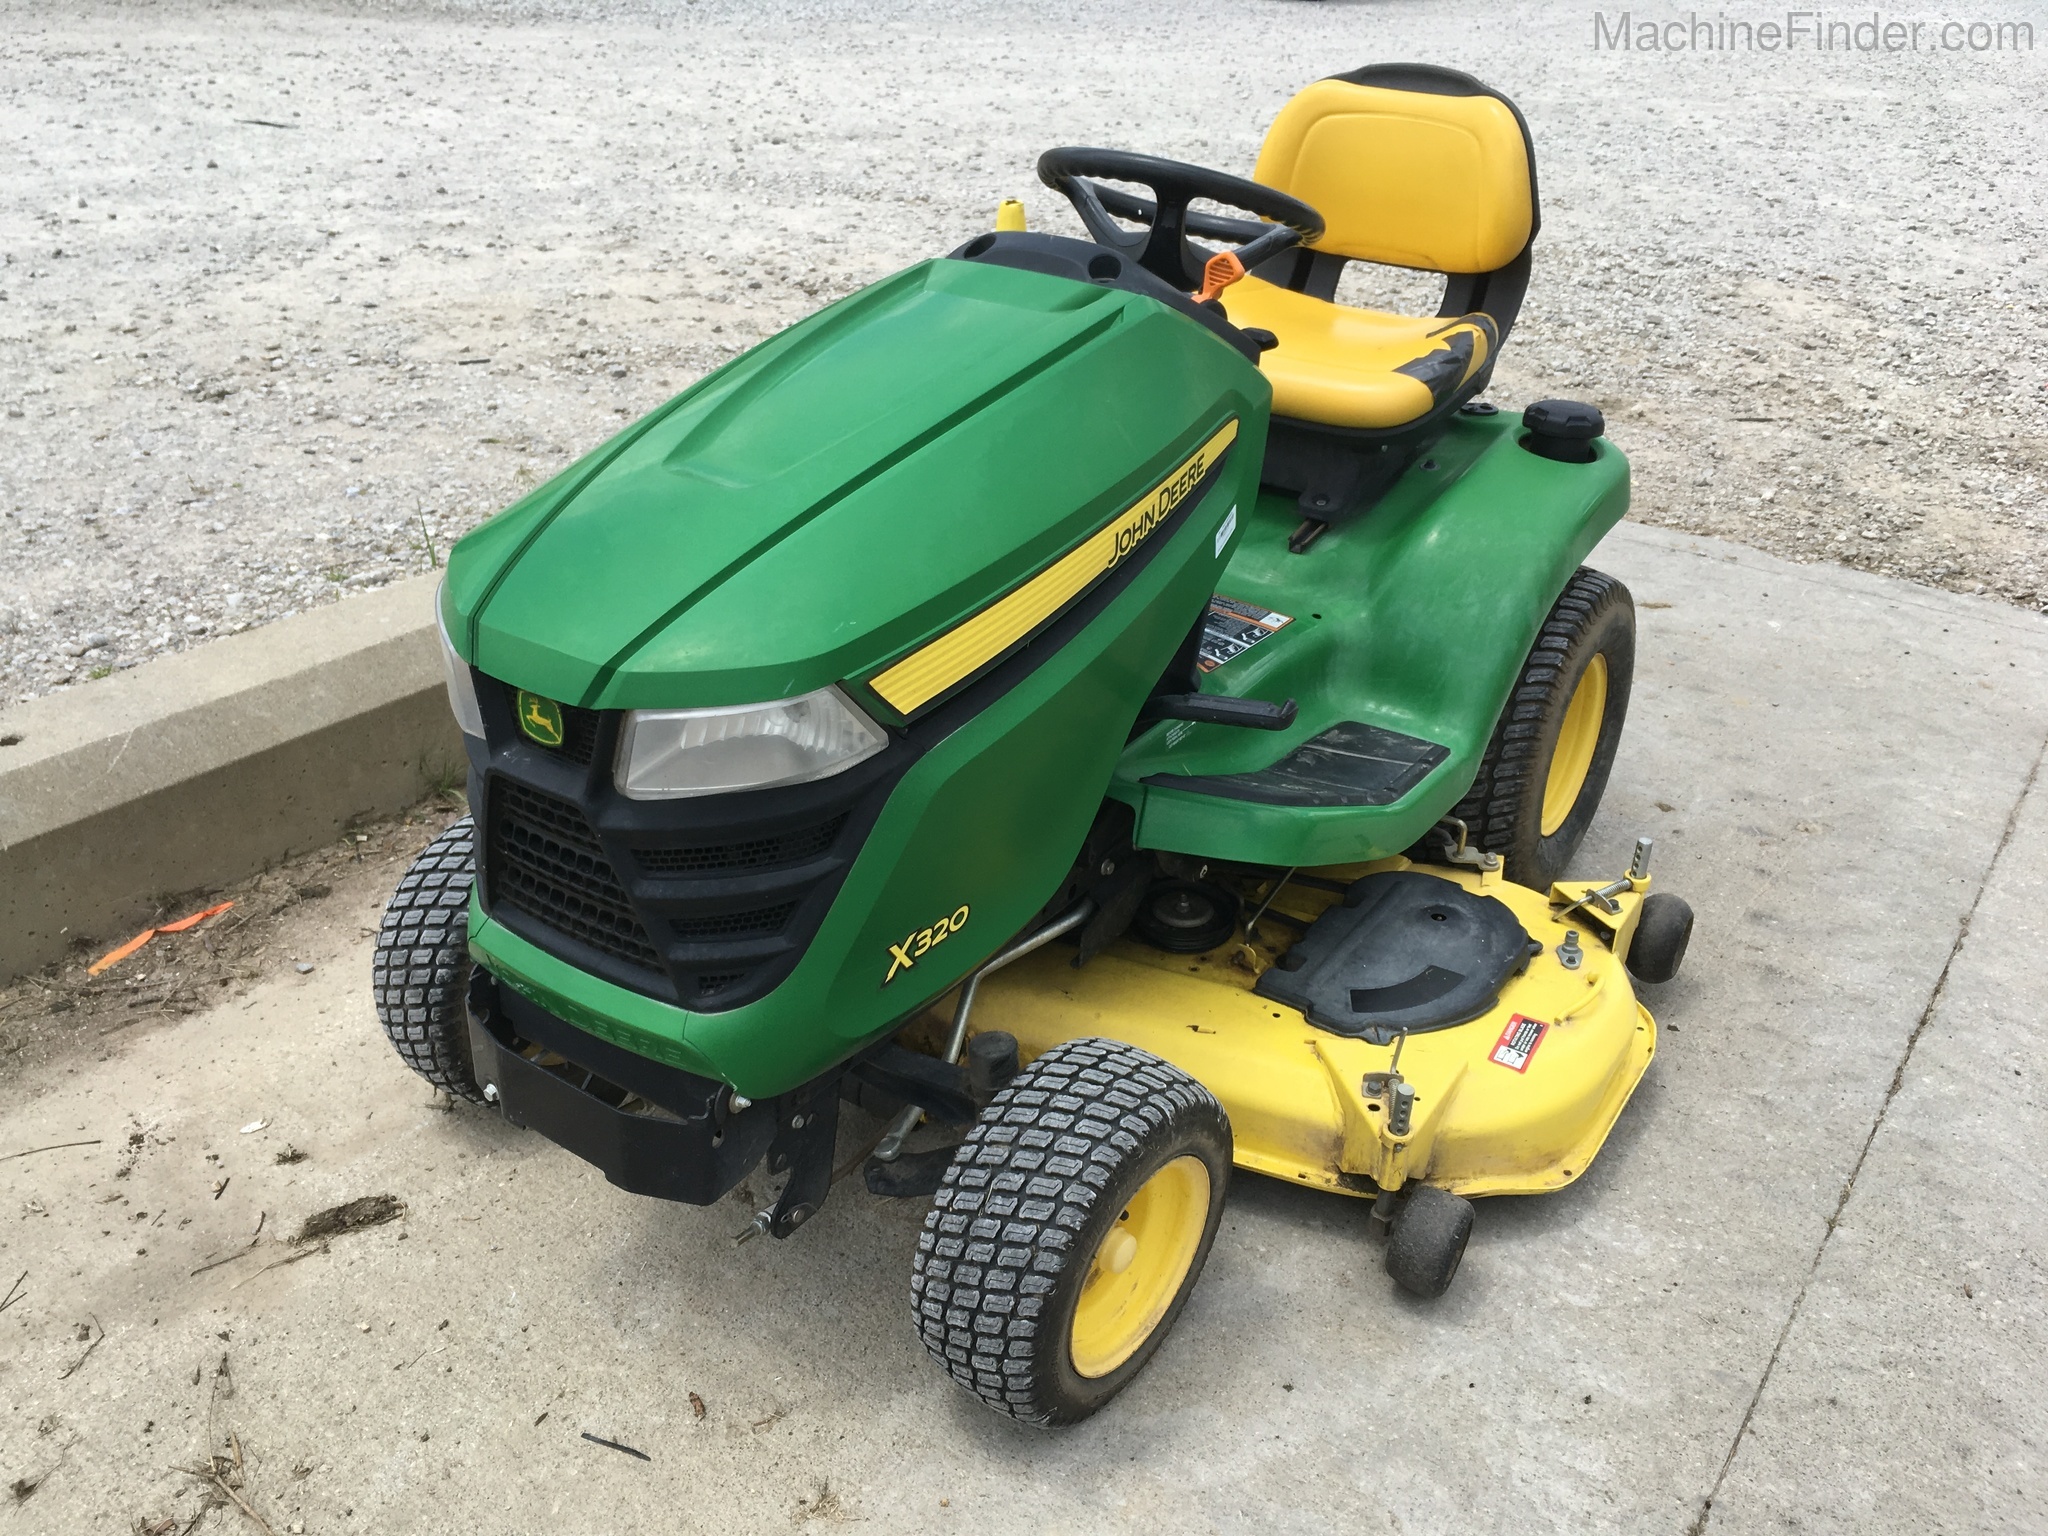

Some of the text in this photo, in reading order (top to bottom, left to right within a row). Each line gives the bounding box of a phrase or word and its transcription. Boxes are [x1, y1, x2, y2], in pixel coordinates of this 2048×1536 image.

[1108, 504, 1155, 566] JOHN
[1158, 453, 1205, 520] DEERE
[884, 904, 970, 985] X320
